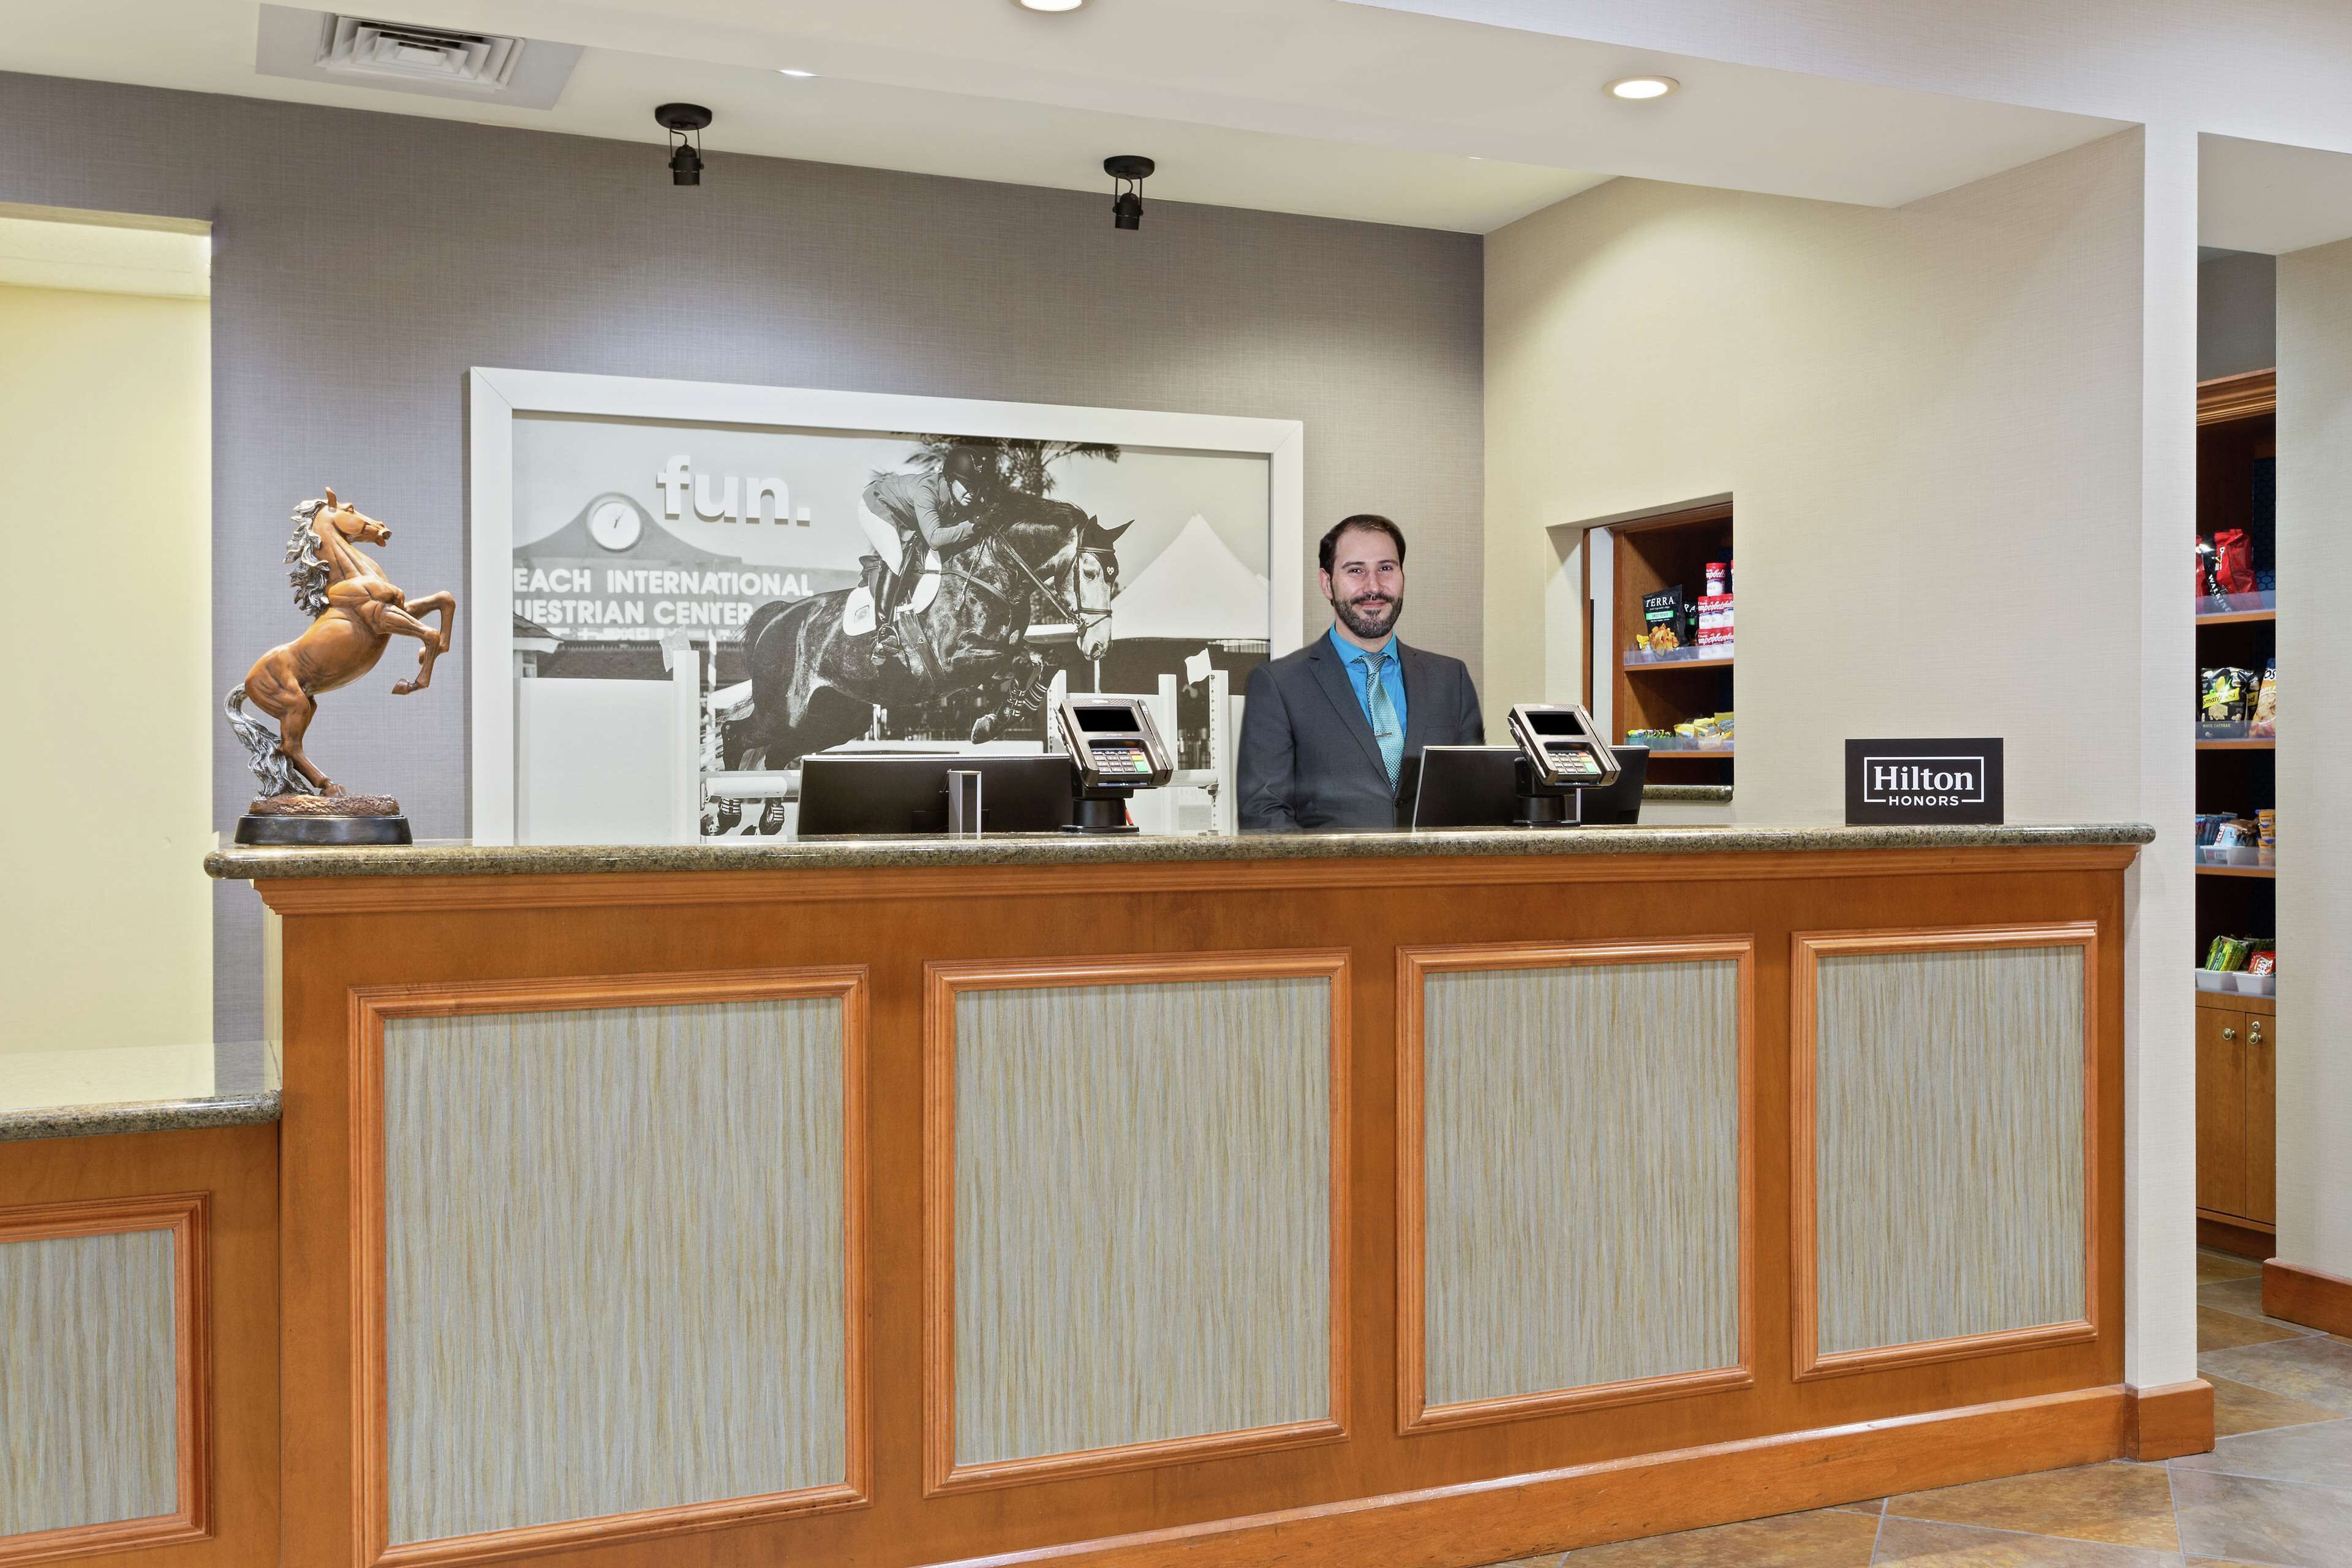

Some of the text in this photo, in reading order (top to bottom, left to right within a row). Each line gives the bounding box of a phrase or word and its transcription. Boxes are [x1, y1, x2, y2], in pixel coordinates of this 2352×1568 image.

[657, 455, 810, 522] fun.
[513, 568, 813, 596] EACH INTERNATIONAL
[654, 600, 753, 625] CENTER
[1646, 596, 1674, 608] TERRA
[1874, 766, 1974, 791] Hilton
[1889, 796, 1959, 806] HONORS
